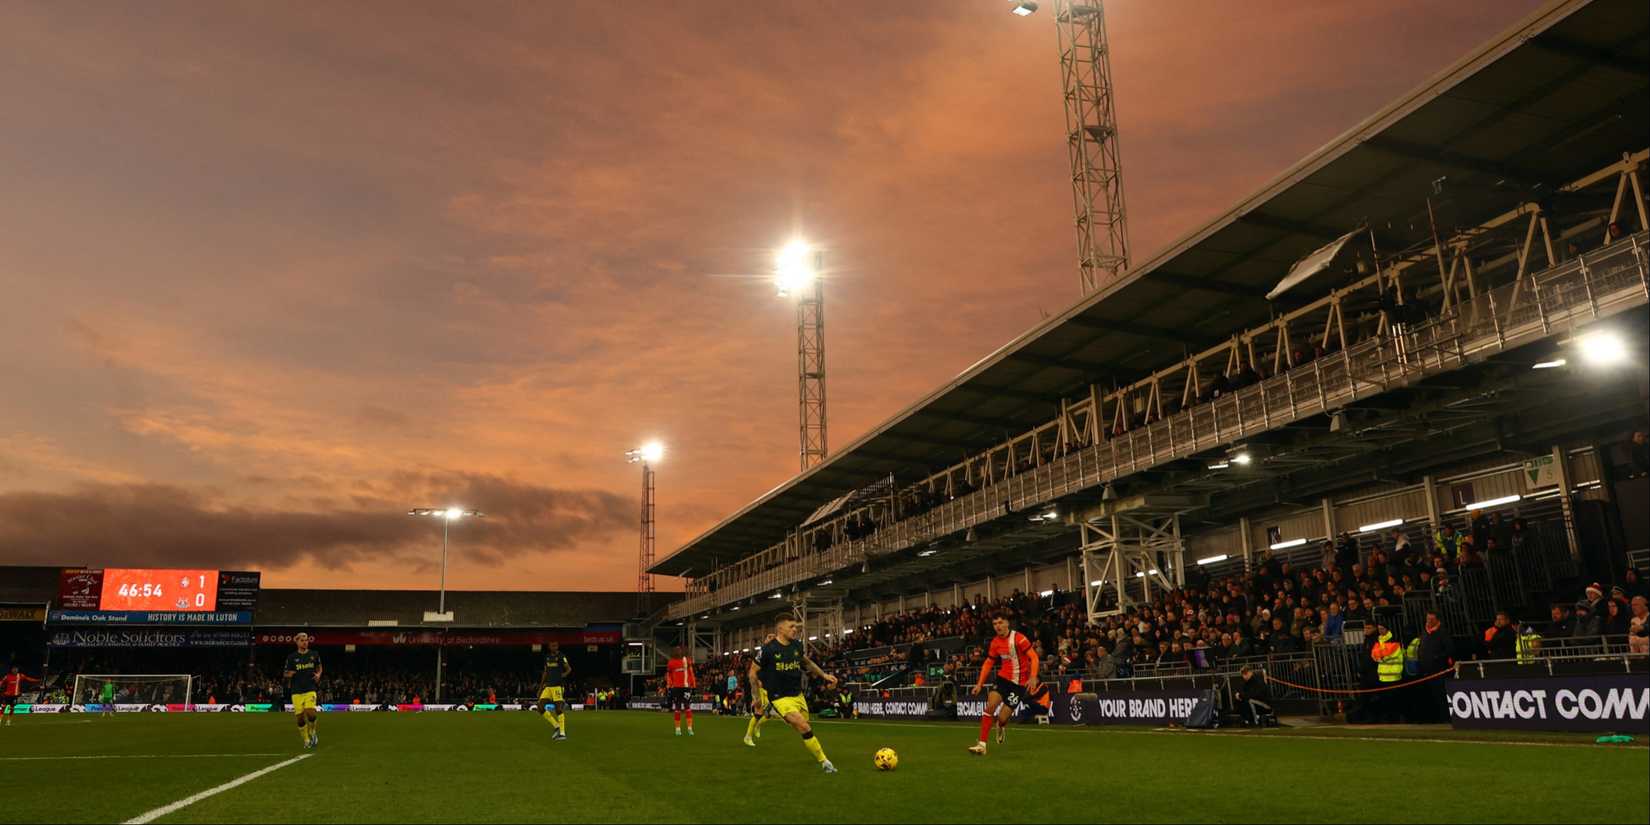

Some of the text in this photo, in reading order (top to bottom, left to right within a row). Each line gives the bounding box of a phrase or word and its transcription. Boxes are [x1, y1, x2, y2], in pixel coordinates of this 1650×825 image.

[199, 575, 206, 589] 1
[118, 584, 162, 599] 46:54
[195, 592, 206, 607] 0
[147, 613, 238, 622] HISTORY IS MADE IN LUTON
[73, 631, 119, 643] Noble
[121, 631, 186, 643] Solicitors
[1007, 691, 1019, 703] 26
[1098, 698, 1127, 718] YOUR
[1128, 698, 1166, 718] BRAND
